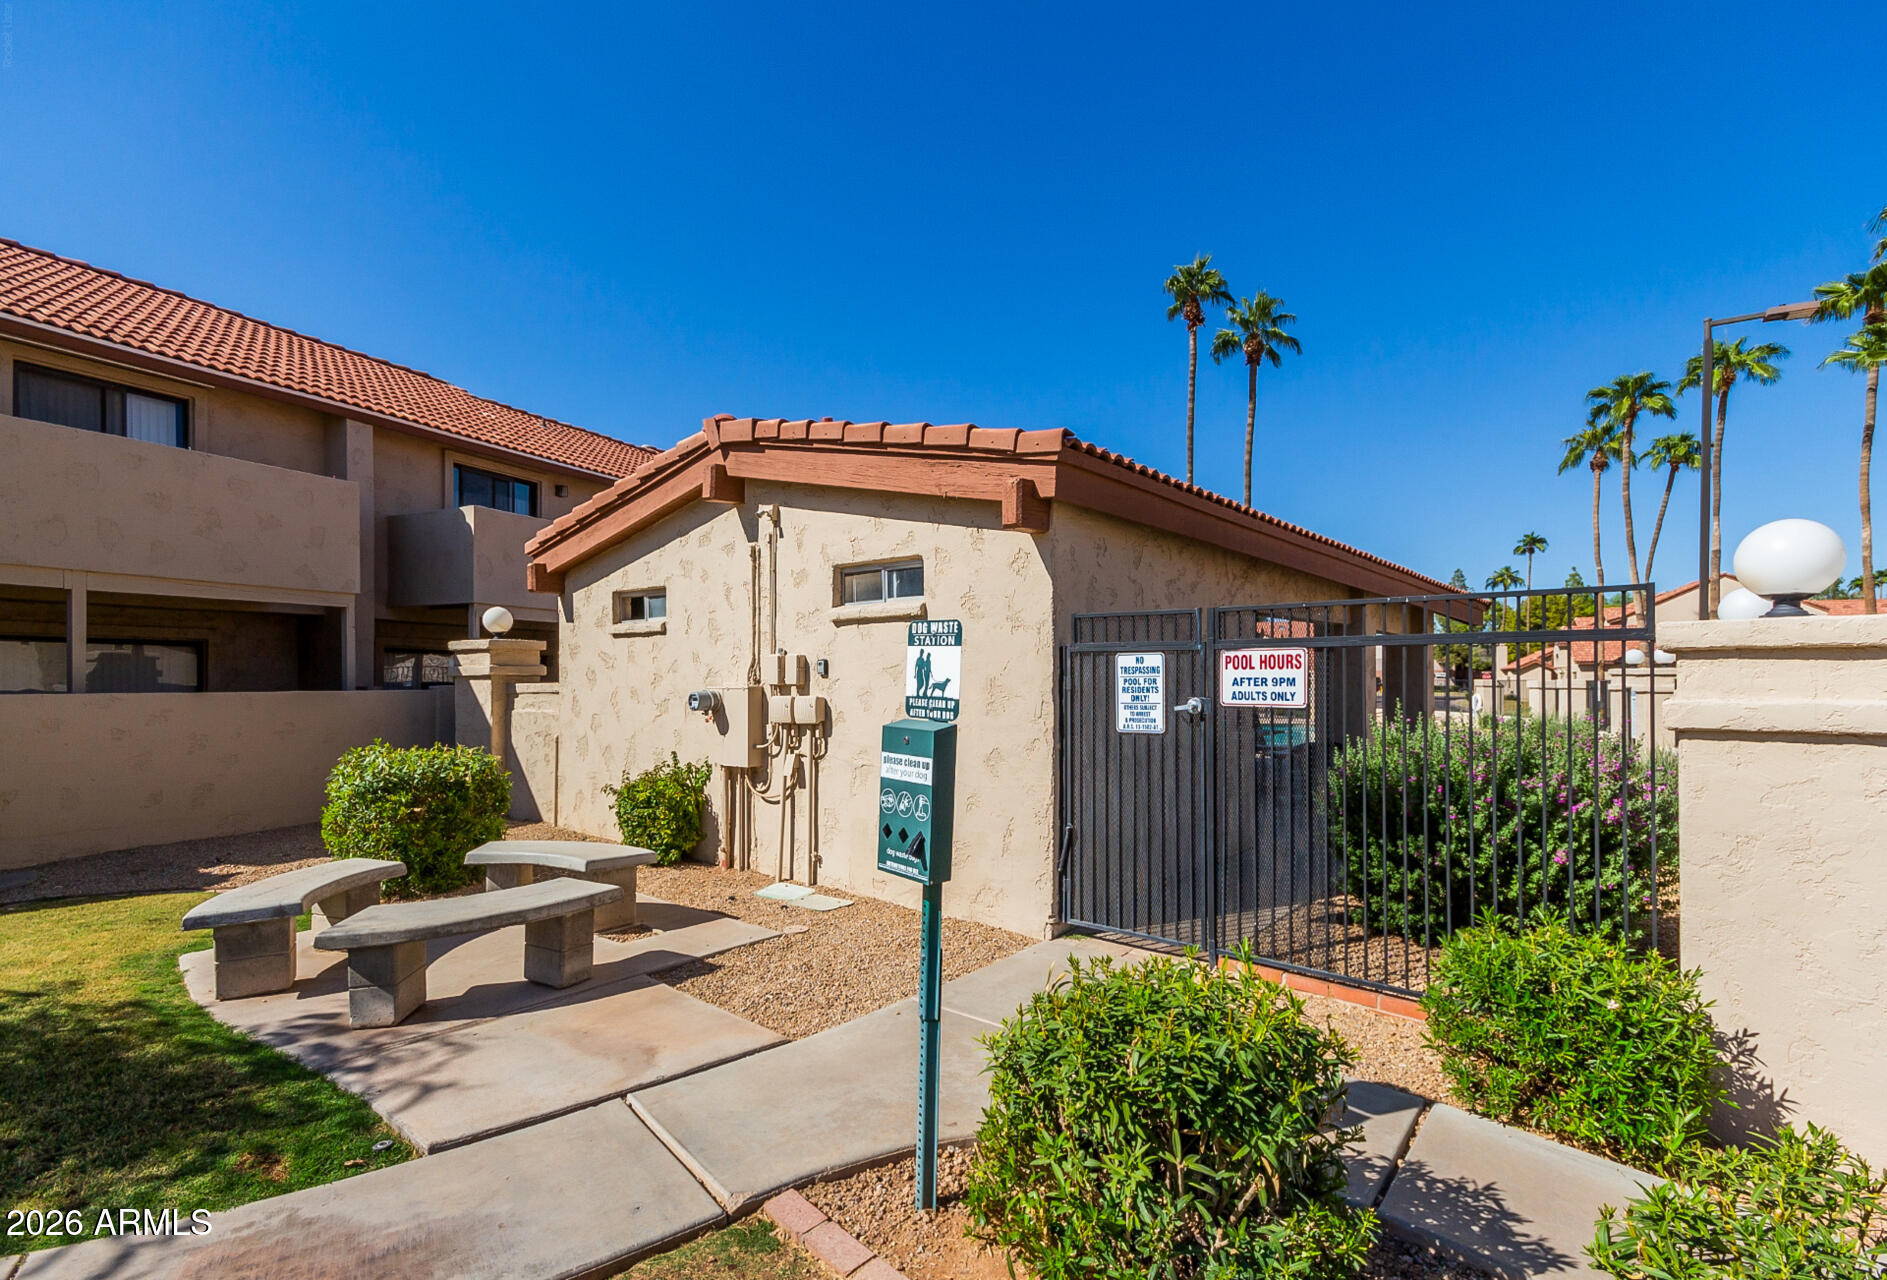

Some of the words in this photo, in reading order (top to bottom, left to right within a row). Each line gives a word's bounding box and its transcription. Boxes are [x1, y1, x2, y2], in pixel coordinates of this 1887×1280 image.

[912, 622, 928, 634] DOG
[930, 621, 958, 634] WASTE
[914, 635, 955, 646] STATION
[1135, 656, 1145, 665] NO
[1225, 654, 1255, 670] POOL
[1259, 654, 1303, 670] HOURS
[1120, 666, 1161, 675] TRESPASSING
[1123, 678, 1142, 686] POOL
[1143, 678, 1158, 686] FOR
[1232, 677, 1268, 687] AFTER
[1271, 677, 1296, 687] 9PM
[1121, 686, 1159, 694] RESIDENTS
[1130, 694, 1150, 703] ONLY!
[1231, 691, 1268, 702] ADULTS
[1270, 692, 1297, 702] ONLY
[909, 697, 928, 707] PLEASE
[883, 755, 903, 766] please
[904, 757, 921, 769] clean
[922, 761, 931, 771] up
[900, 768, 914, 777] your
[915, 771, 928, 782] dog
